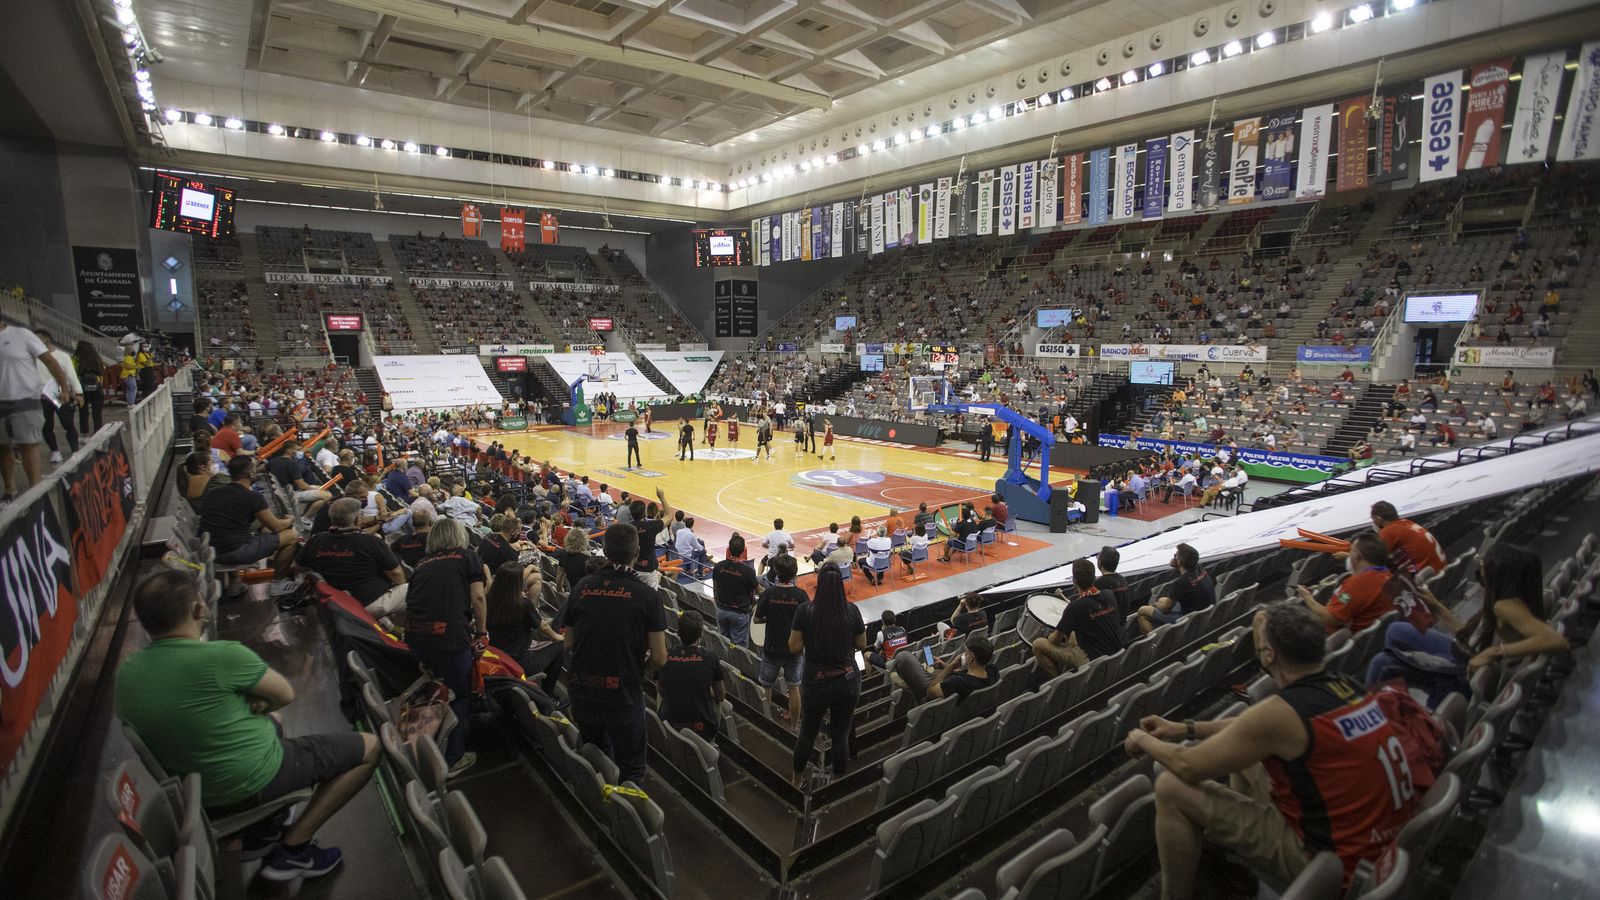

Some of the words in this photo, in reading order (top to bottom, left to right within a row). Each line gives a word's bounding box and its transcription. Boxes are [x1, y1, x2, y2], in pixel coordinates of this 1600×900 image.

[1430, 81, 1454, 152] asisa
[1468, 95, 1504, 109] PUREZA
[1354, 129, 1364, 185] ANTONIO
[1002, 171, 1014, 217] asisa
[1023, 164, 1033, 214] BERNER
[1046, 179, 1055, 215] Cuerva
[1125, 161, 1135, 216] ESCOLANO
[1174, 153, 1186, 209] emasagra
[938, 192, 947, 237] NEPTUNO
[80, 270, 136, 279] AYUNTAMIENTO
[269, 273, 306, 282] IDEAL
[1040, 345, 1065, 353] asisa
[1223, 347, 1255, 357] Cuerva
[1243, 452, 1265, 460] PULEVA
[1267, 454, 1290, 462] PULEVA
[1293, 457, 1316, 465] PULEVA
[1377, 736, 1415, 811] 13
